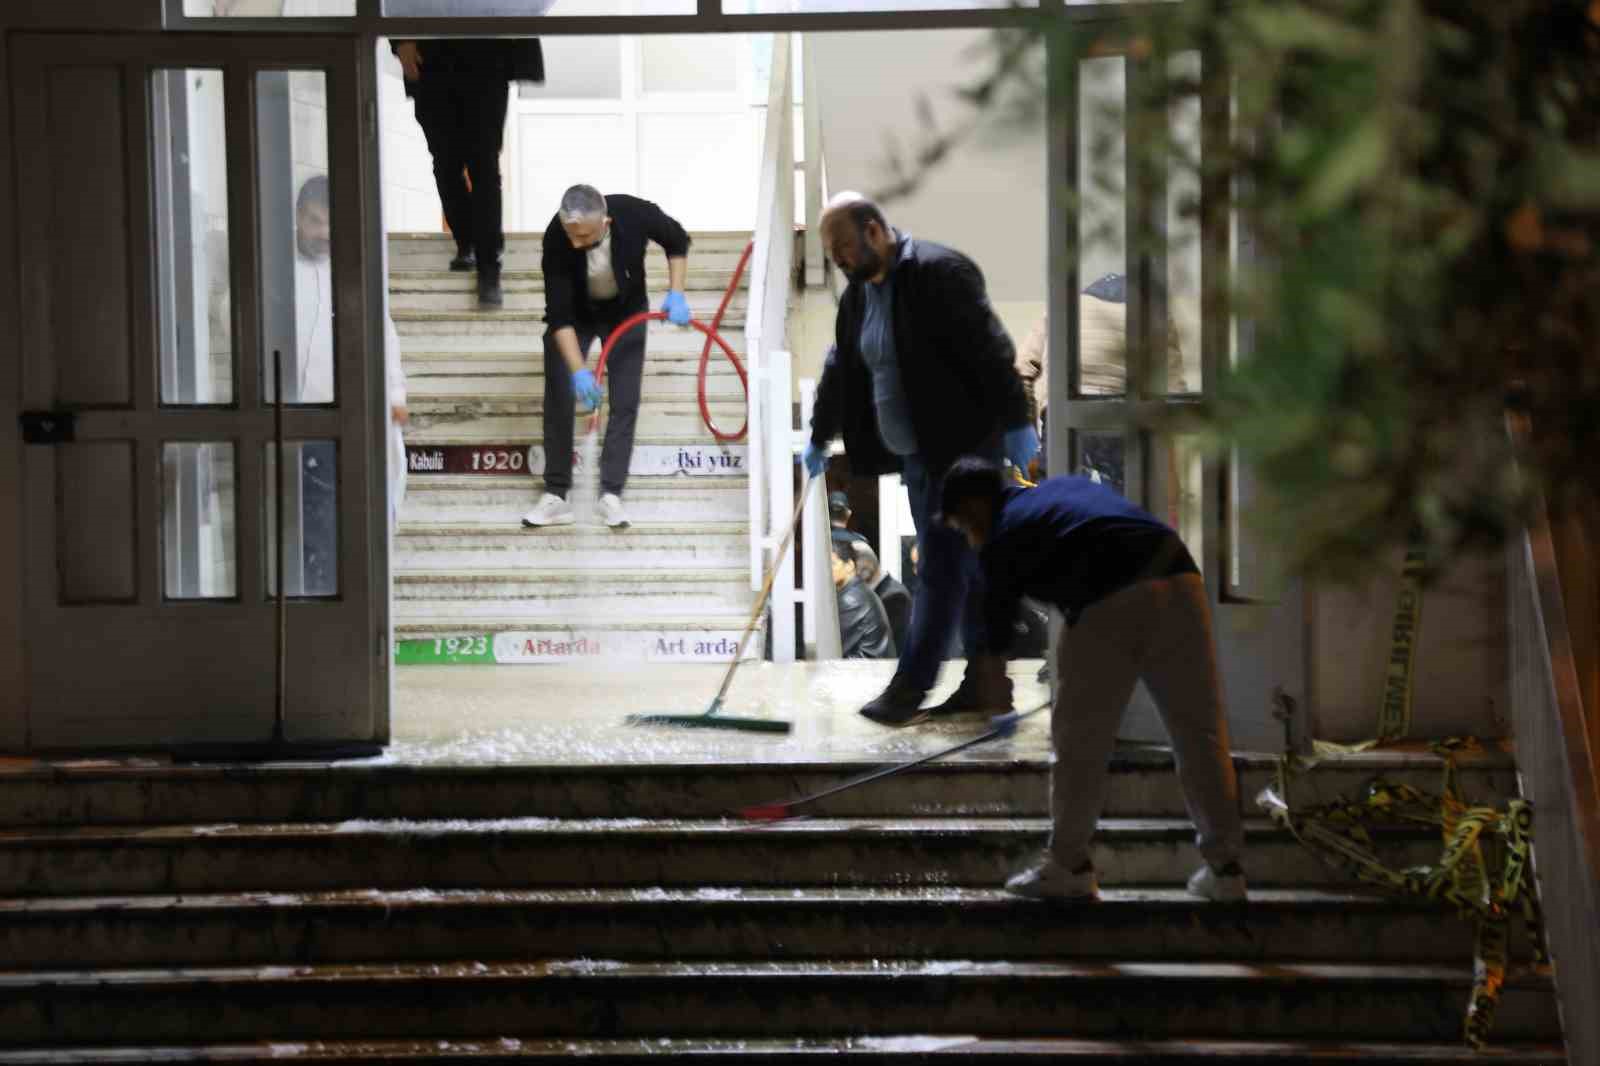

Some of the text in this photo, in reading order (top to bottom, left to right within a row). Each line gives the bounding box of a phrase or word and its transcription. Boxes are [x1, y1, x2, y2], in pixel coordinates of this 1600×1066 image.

[471, 452, 524, 470] 1920
[708, 450, 743, 472] yüz
[434, 635, 489, 656] 1923
[655, 637, 739, 655] Art arda
